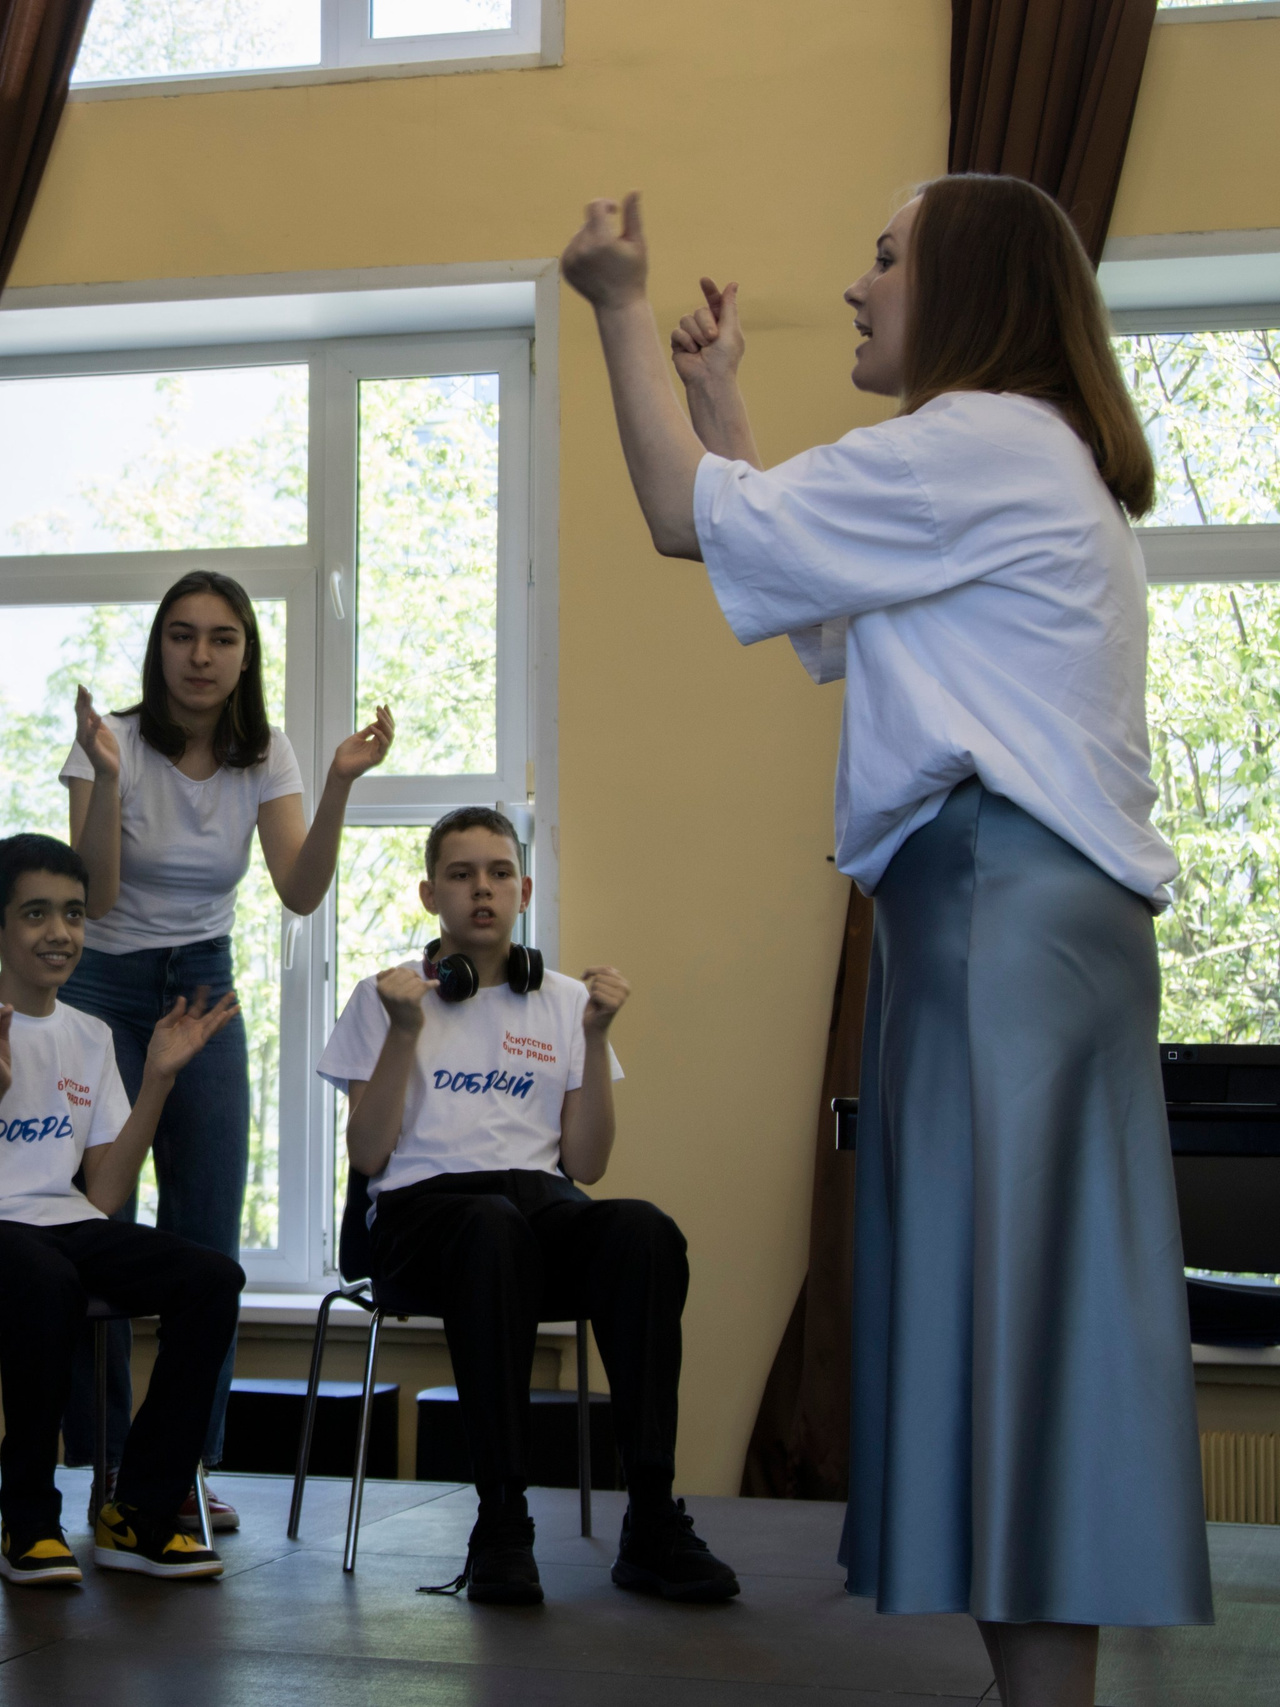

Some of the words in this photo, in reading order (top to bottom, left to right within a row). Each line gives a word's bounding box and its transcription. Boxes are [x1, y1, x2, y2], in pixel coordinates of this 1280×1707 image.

[505, 1030, 553, 1051] Искусство
[526, 1049, 556, 1063] рядом
[433, 1069, 535, 1099] ДОБРЫЙ
